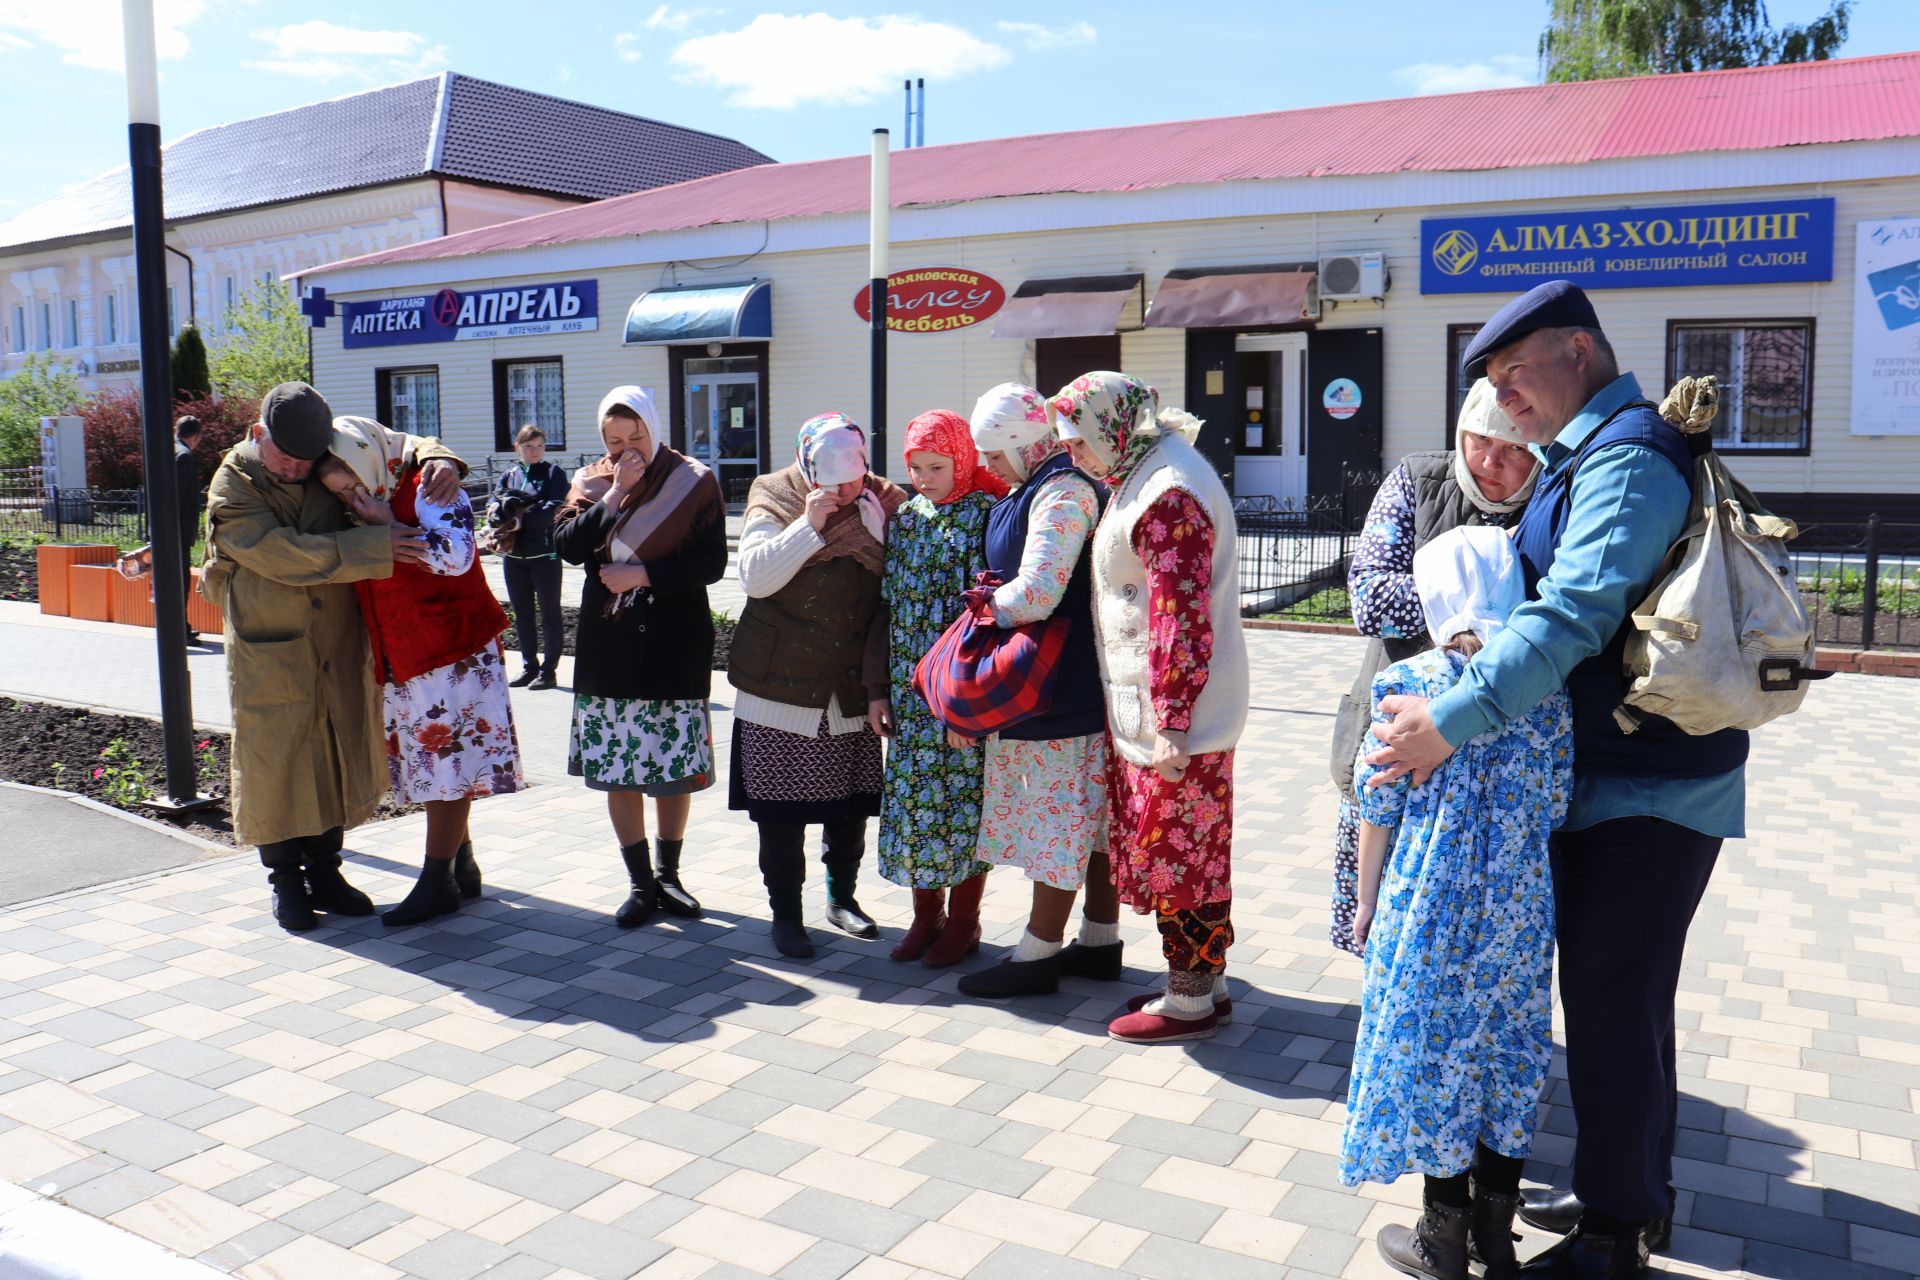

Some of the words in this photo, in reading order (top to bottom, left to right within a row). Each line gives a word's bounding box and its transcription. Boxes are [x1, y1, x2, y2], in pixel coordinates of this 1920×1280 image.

[1485, 212, 1809, 252] АЛМАЗ-ХОЛДИНГ
[1480, 257, 1595, 276] ФИРМЕННЫЙ
[1605, 252, 1728, 272] ЮВЕЛИРНЫЙ
[1738, 251, 1808, 268] САЛОН
[886, 271, 980, 288] льяновская
[456, 286, 581, 326] АПРЕЛЬ
[350, 310, 421, 334] АПТЕКА
[507, 323, 551, 335] АПТЕЧНЫЙ
[562, 321, 583, 331] КЛУБ
